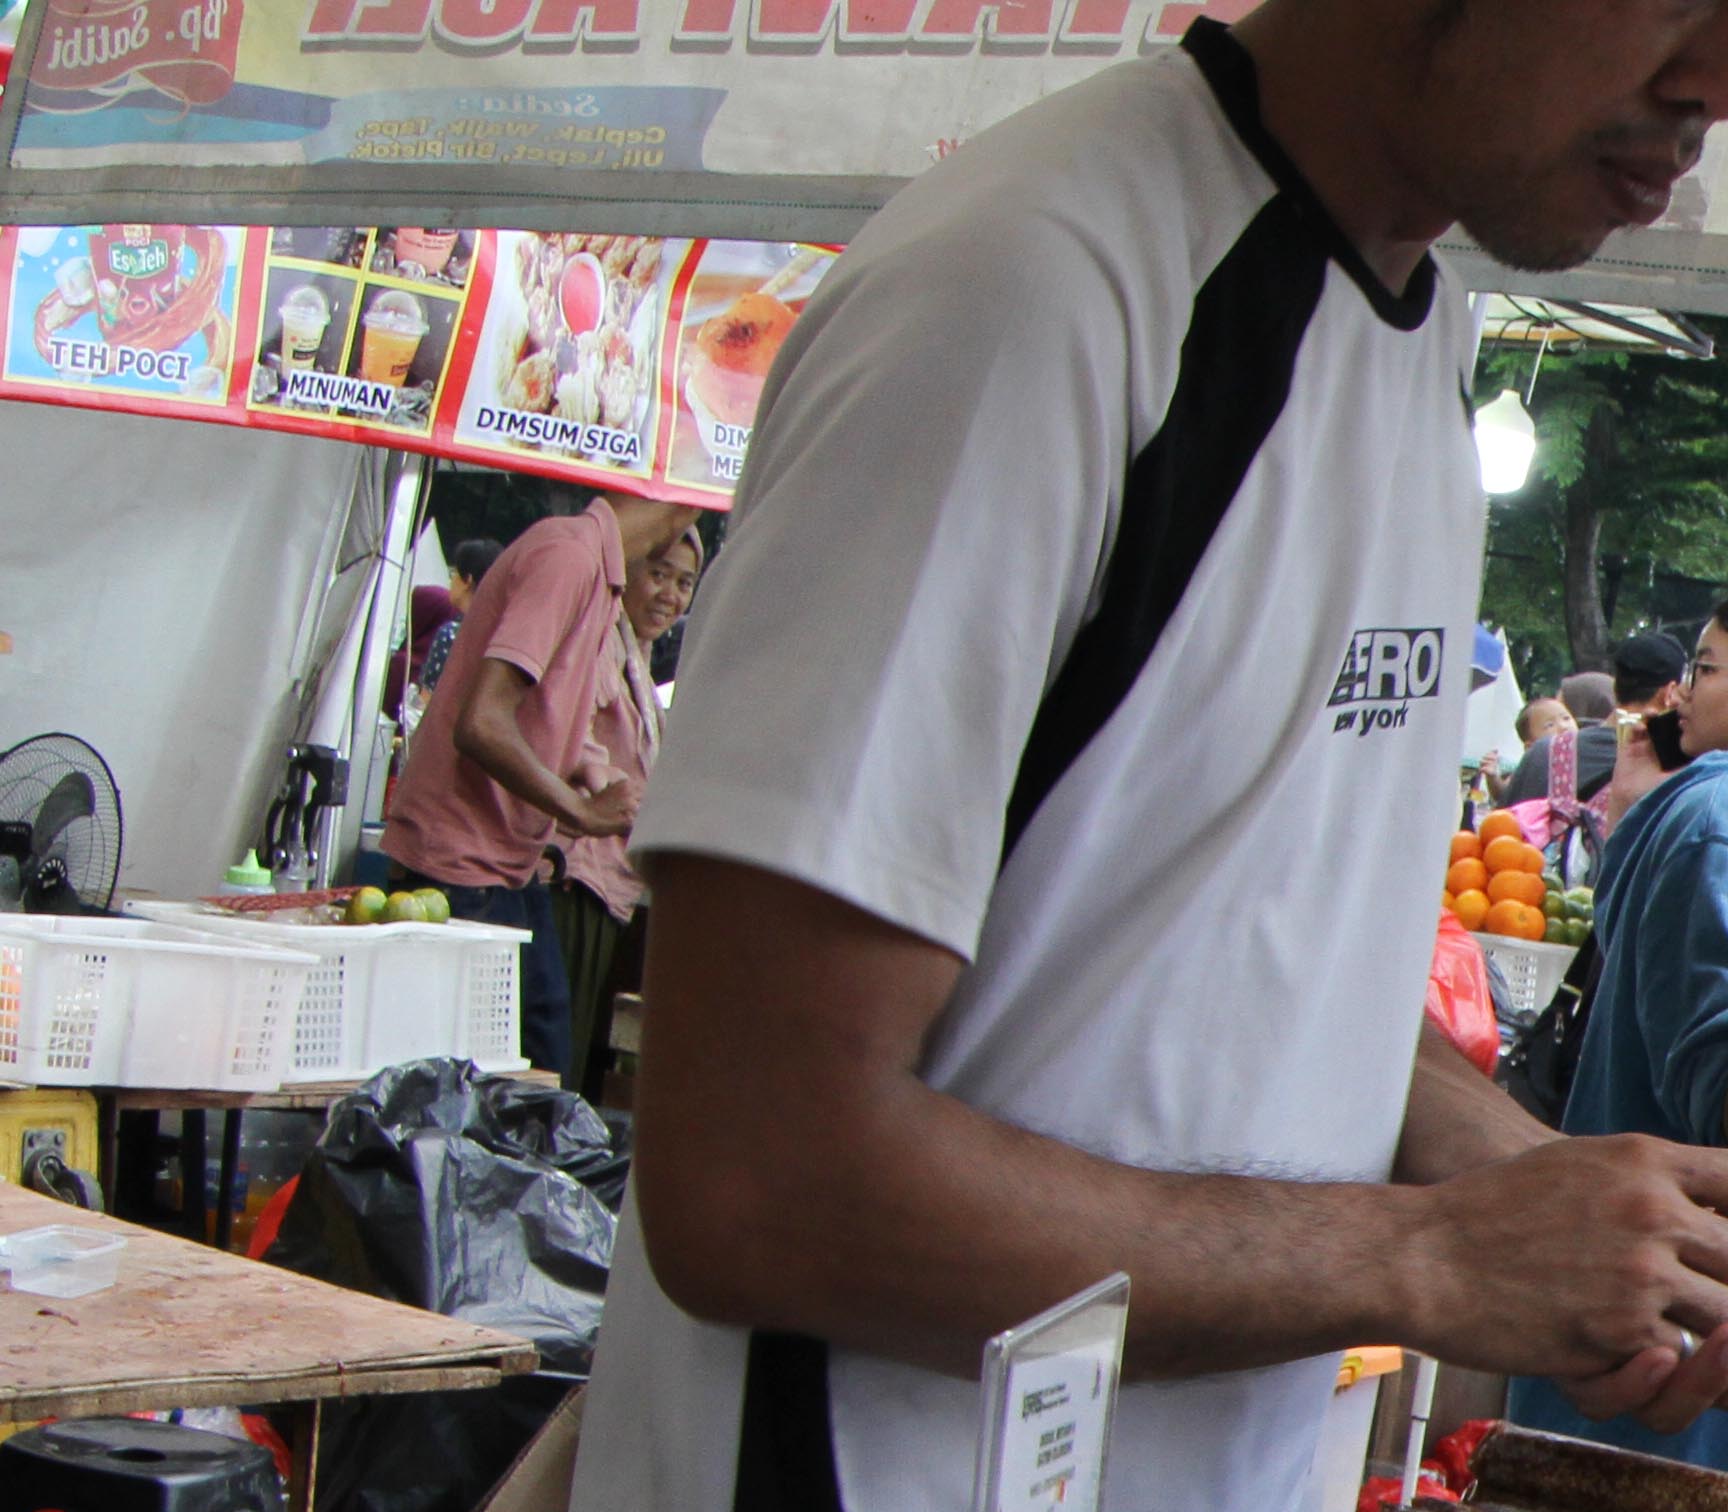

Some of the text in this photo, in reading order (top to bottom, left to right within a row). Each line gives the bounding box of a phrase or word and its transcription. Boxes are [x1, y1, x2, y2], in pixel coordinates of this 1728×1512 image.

[51, 341, 190, 382] TEH POCI
[289, 376, 393, 411] MINUMAN
[476, 407, 639, 458] DIMSUM SIGA
[713, 425, 755, 448] DIM
[1358, 699, 1409, 737] york
